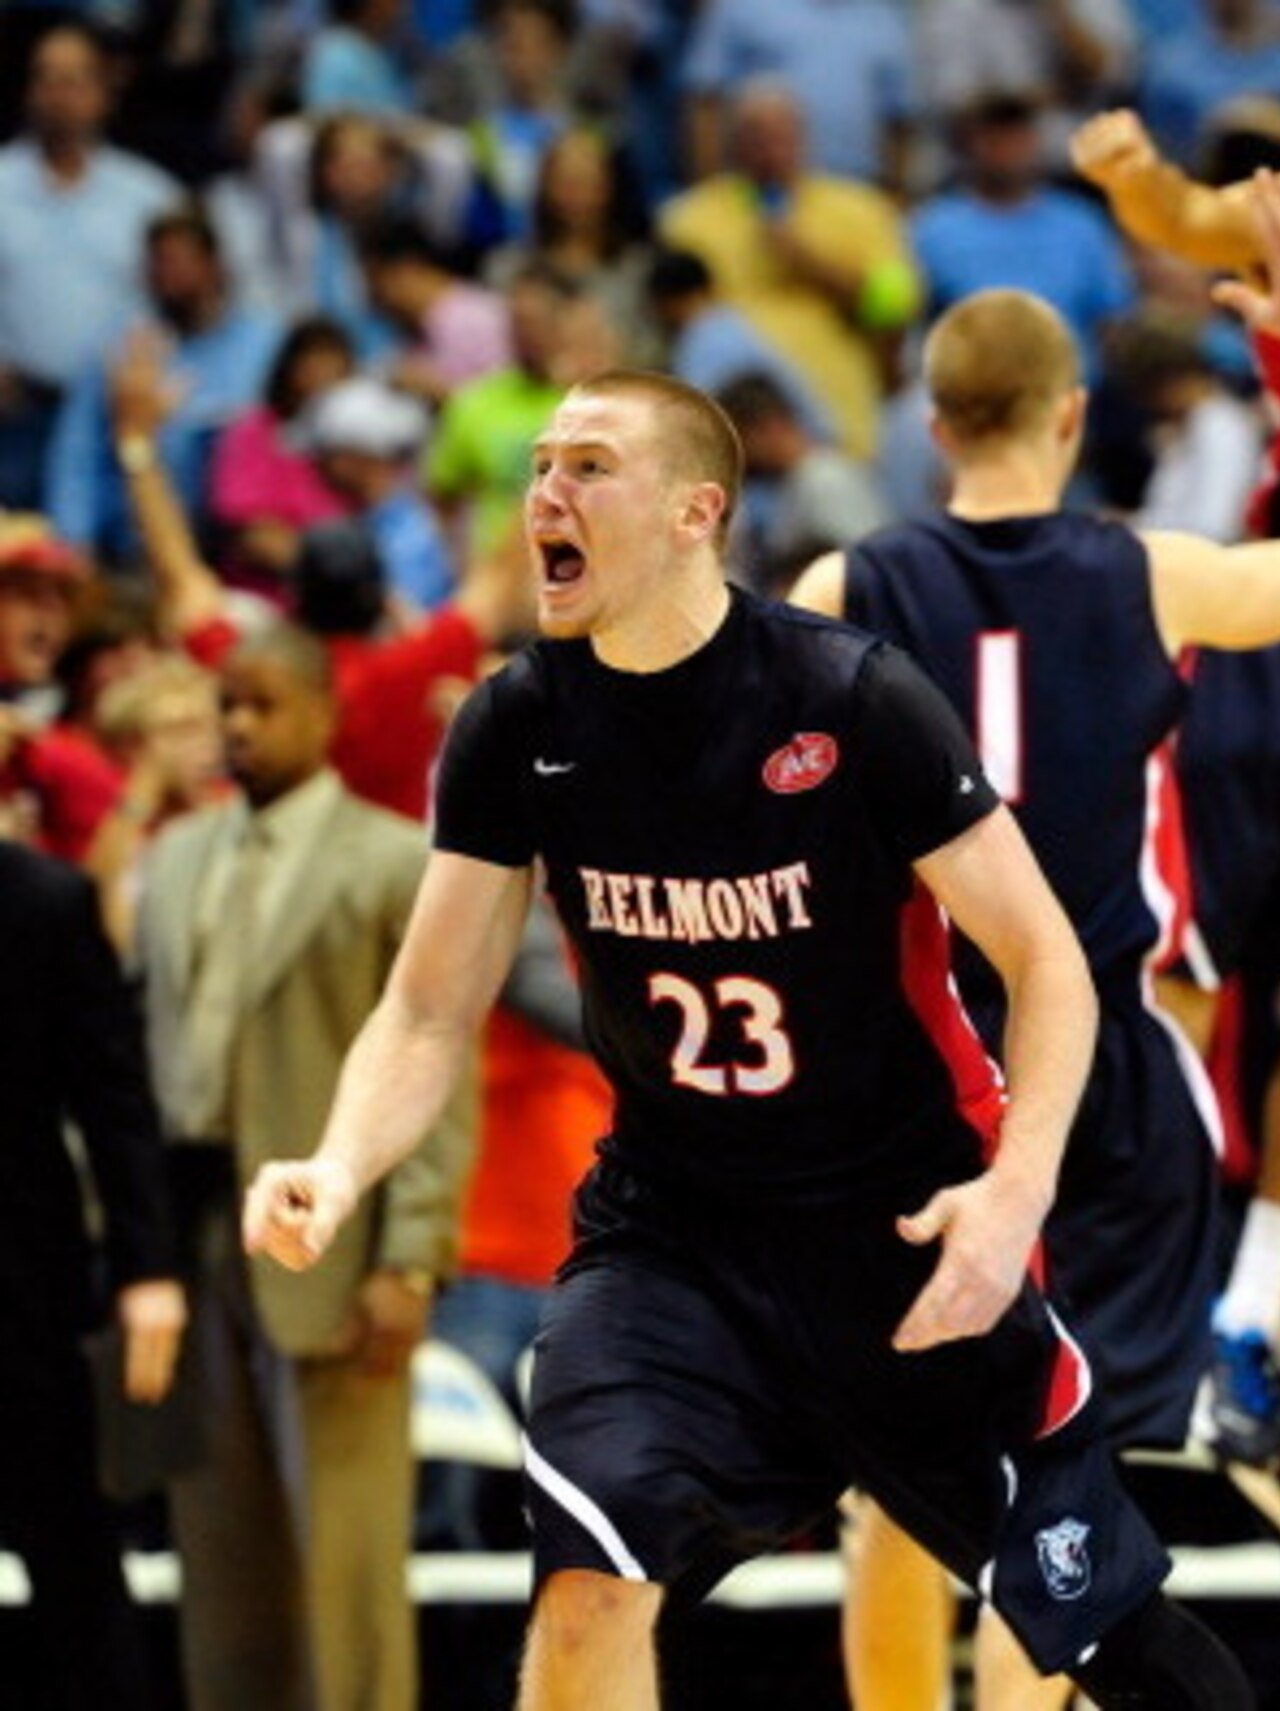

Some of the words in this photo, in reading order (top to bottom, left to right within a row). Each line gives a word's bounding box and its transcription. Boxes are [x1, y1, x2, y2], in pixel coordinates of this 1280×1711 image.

[976, 627, 1021, 803] 1
[579, 862, 812, 944] BELMONT
[648, 973, 797, 1096] 23
